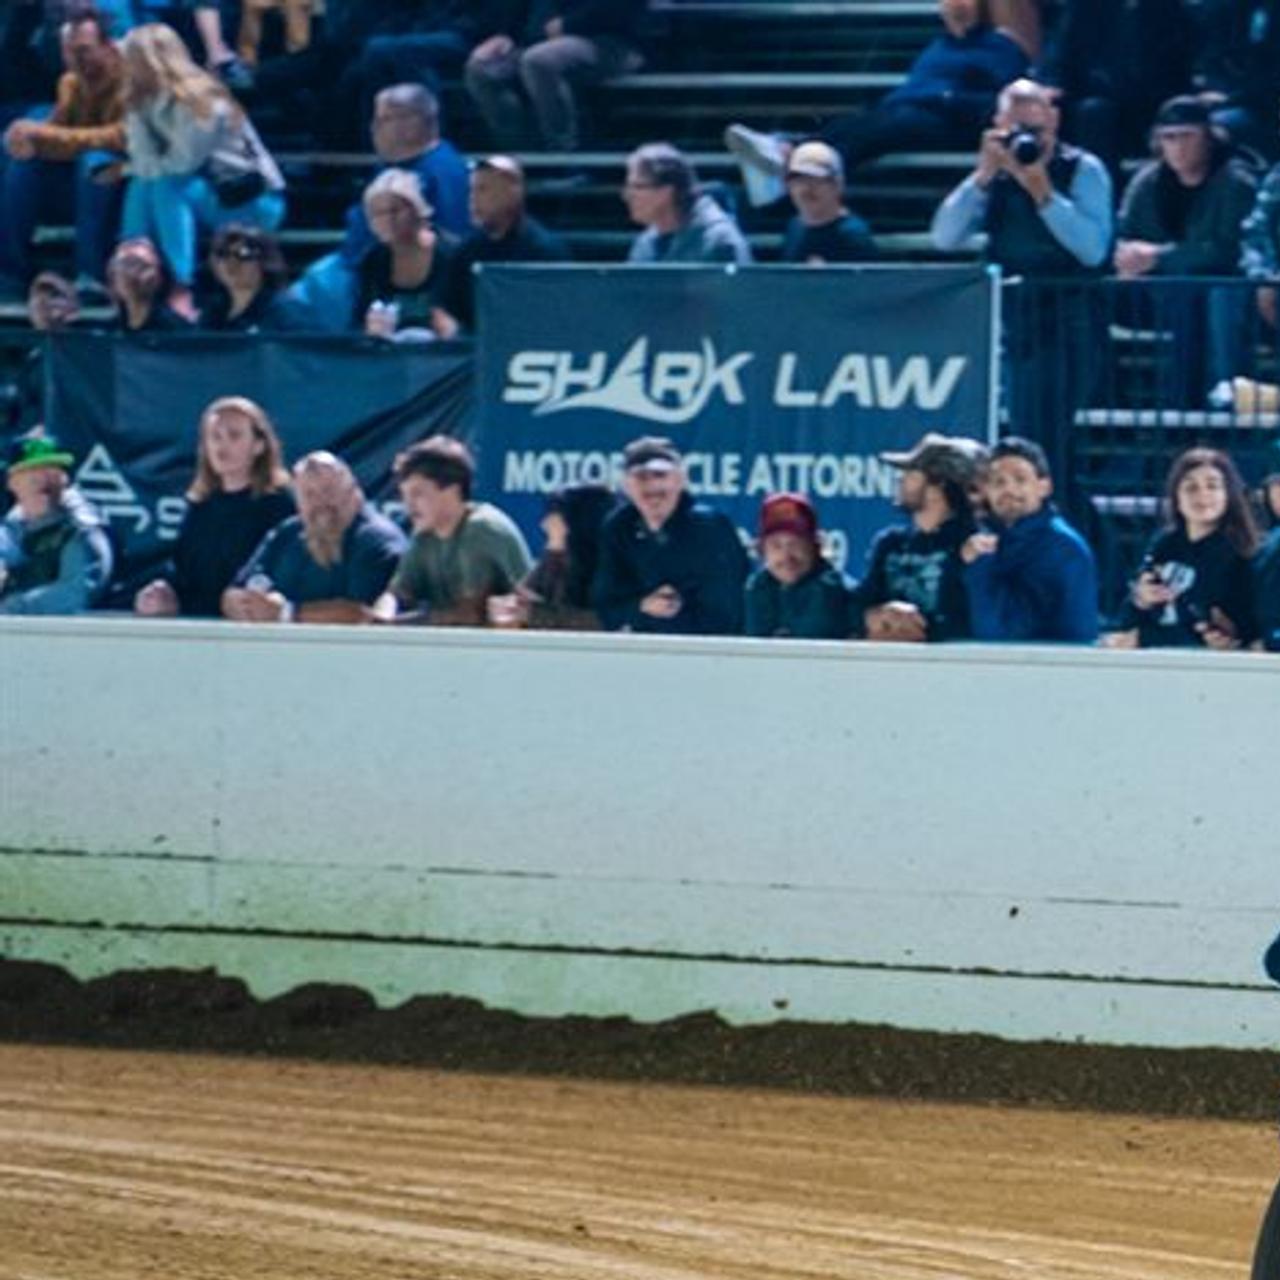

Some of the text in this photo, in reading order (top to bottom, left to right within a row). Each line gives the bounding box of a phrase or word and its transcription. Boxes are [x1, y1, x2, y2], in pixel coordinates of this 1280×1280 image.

[503, 336, 967, 424] SHARK LAW
[504, 451, 740, 497] MOTORCLE
